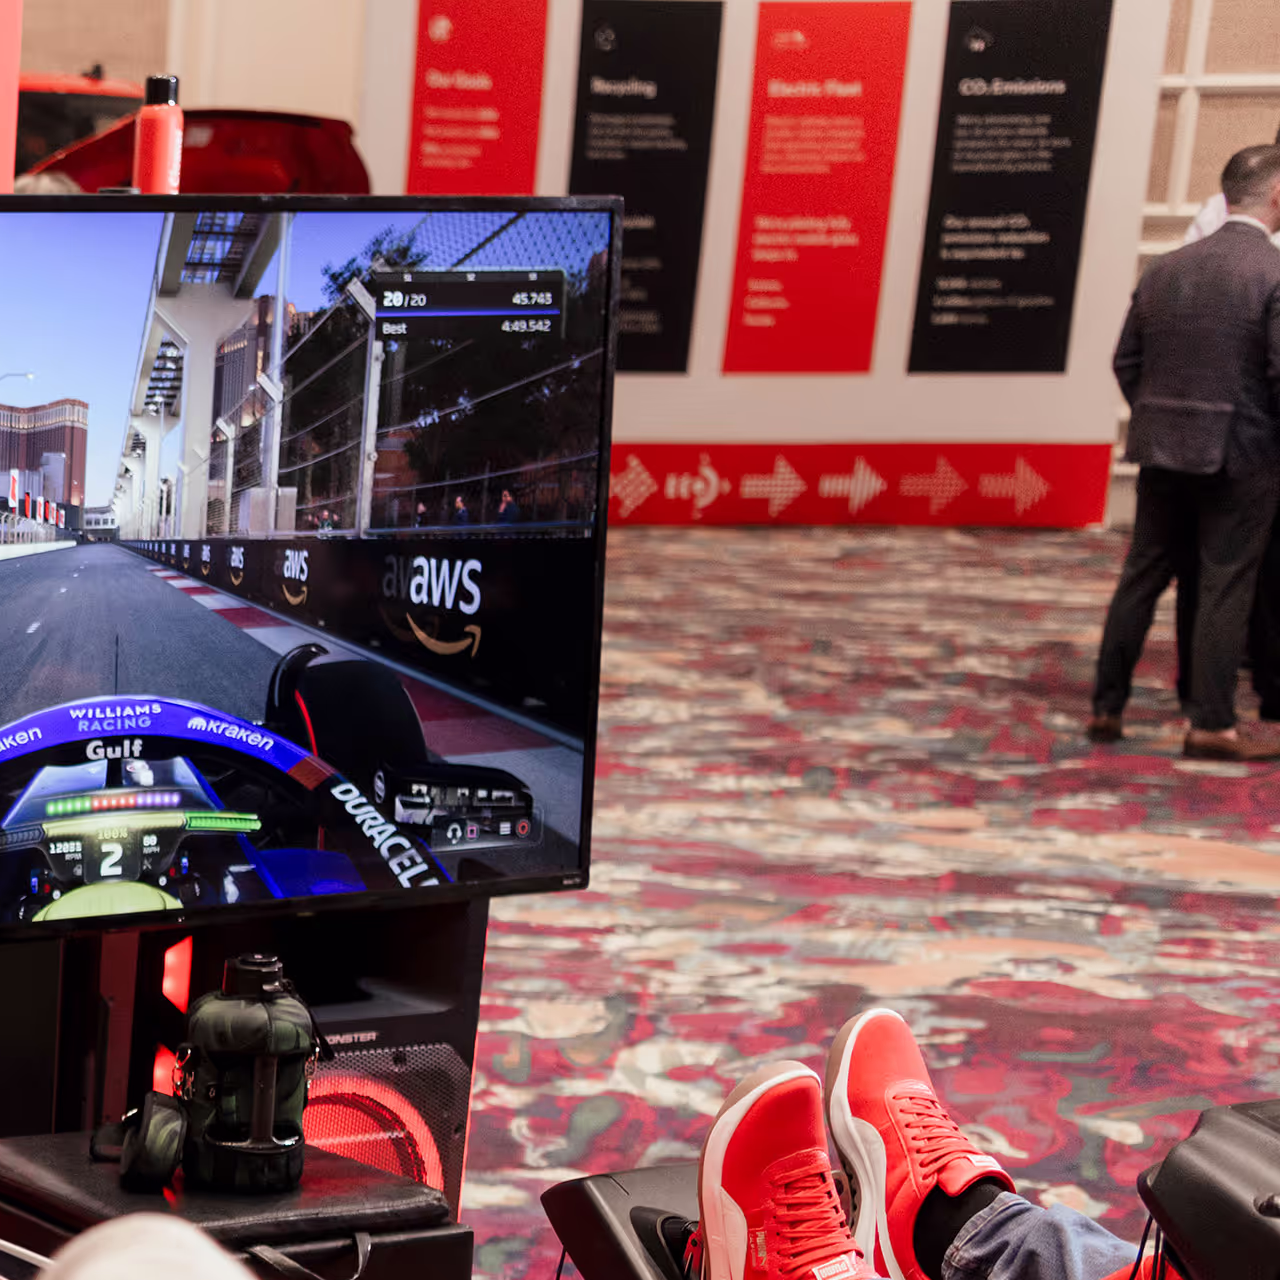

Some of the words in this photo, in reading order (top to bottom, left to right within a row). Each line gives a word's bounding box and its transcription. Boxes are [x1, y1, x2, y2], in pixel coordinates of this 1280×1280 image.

[382, 322, 408, 335] Best
[283, 548, 309, 582] aws
[409, 555, 483, 616] aws
[69, 703, 162, 720] WILLIAMS
[78, 716, 152, 732] RACING
[206, 718, 275, 751] kraken
[86, 738, 144, 760] Gulf
[100, 842, 123, 877] 2
